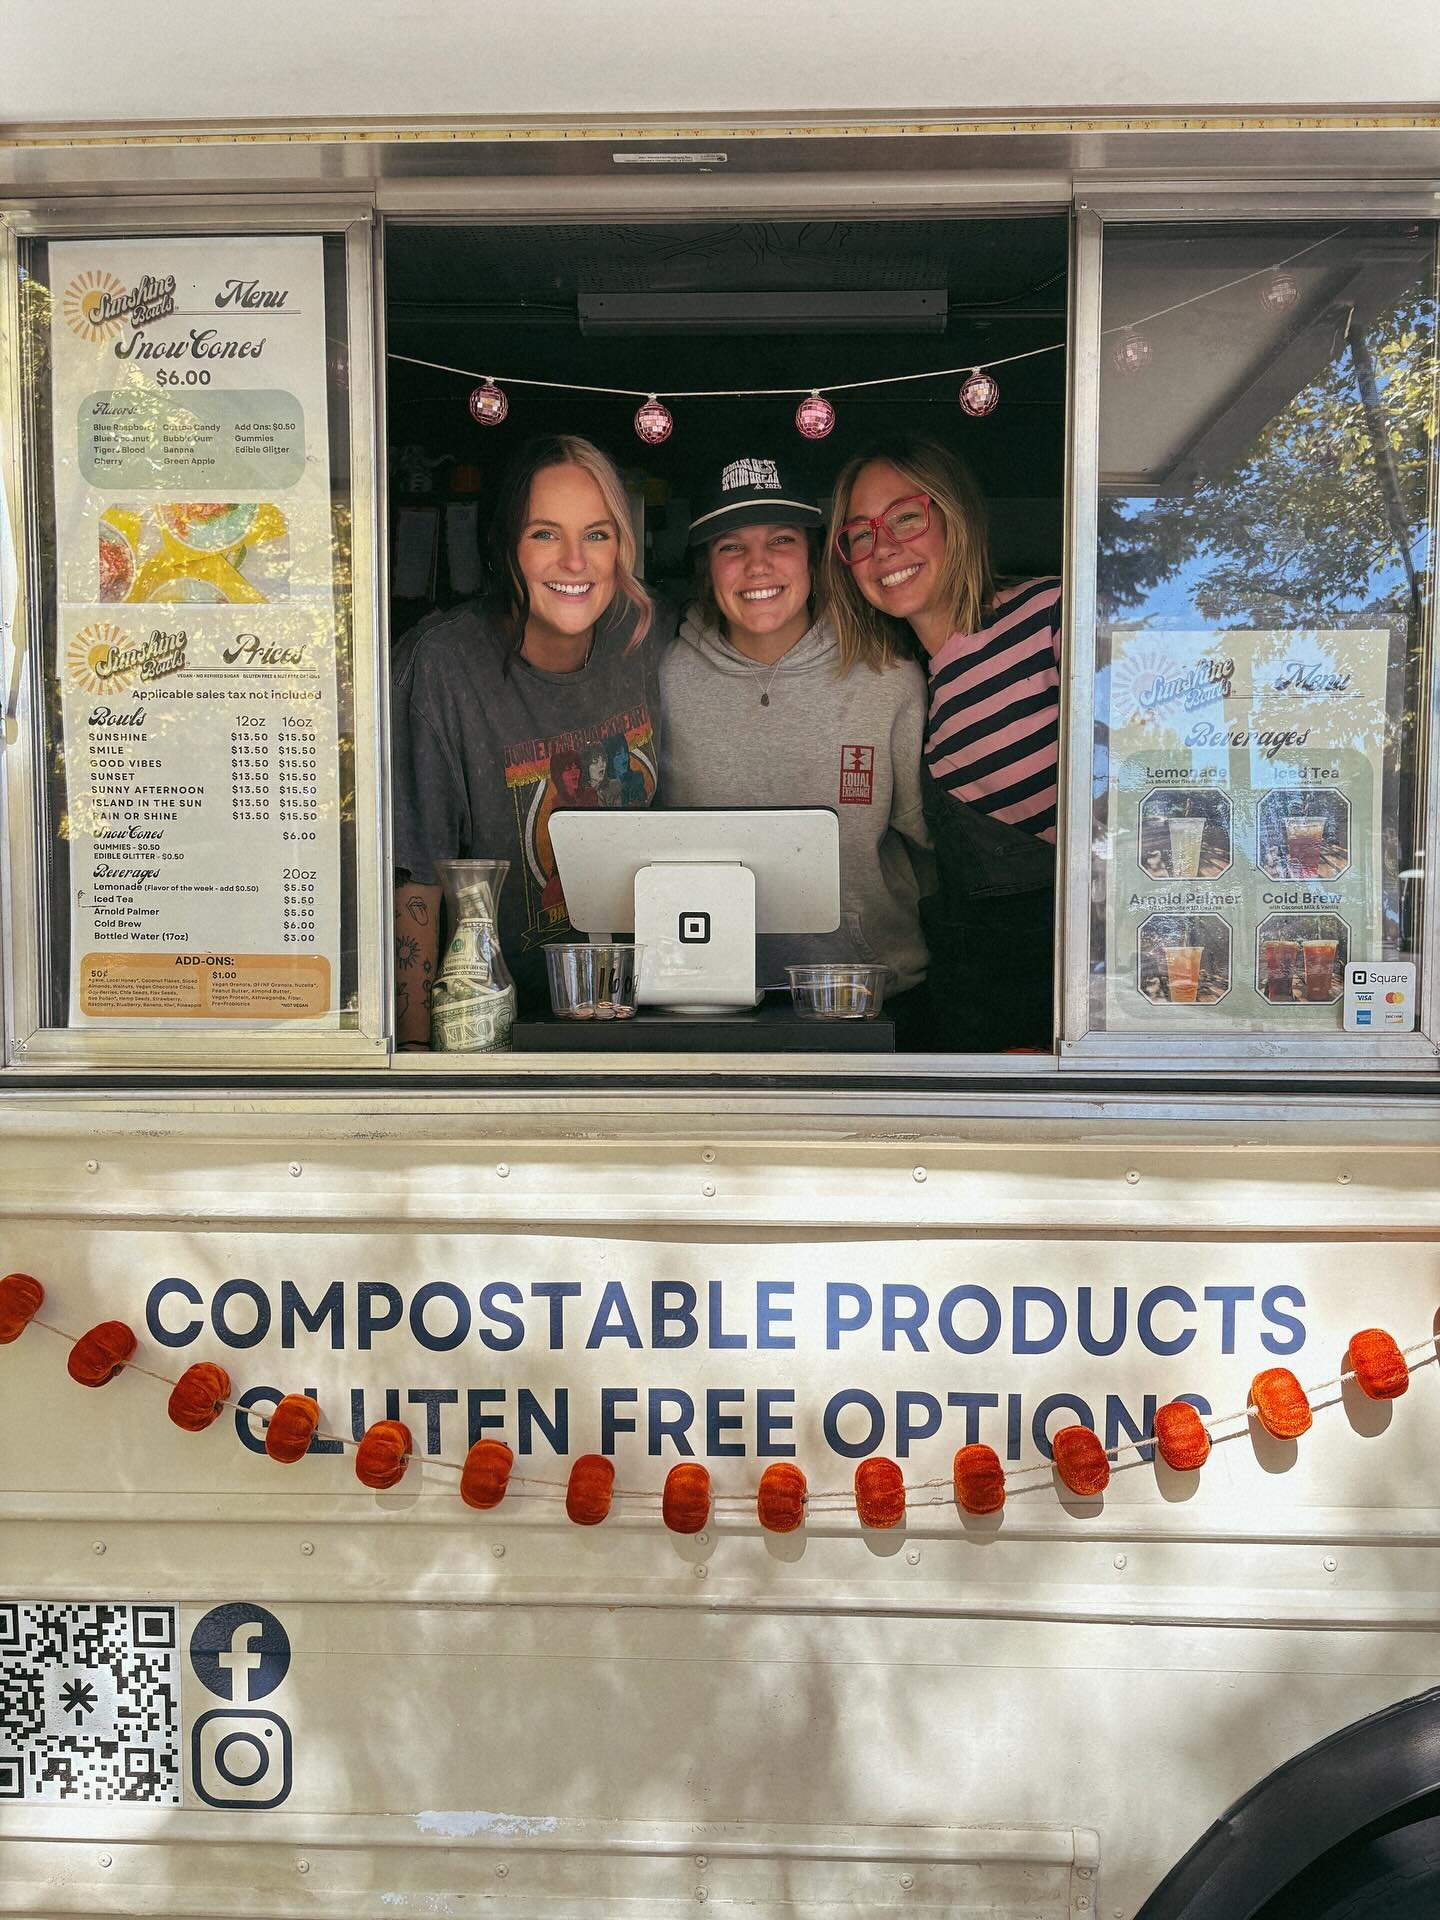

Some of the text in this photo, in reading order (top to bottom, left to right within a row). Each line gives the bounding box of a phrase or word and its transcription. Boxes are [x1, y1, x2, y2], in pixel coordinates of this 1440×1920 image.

[215, 279, 288, 308] Menu
[89, 275, 176, 326] Sunshine
[131, 298, 174, 327] Bowls
[156, 369, 211, 387] $6.00
[195, 424, 220, 432] Candy
[273, 423, 295, 431] $0.50
[235, 434, 274, 442] Gummies
[263, 446, 289, 454] Glitter
[192, 458, 215, 466] Apple
[223, 633, 306, 665] Prices
[95, 630, 188, 679] Sunshine
[140, 651, 185, 681] Bowls
[1274, 662, 1351, 691] Menu
[132, 689, 322, 701] Applicable sales tax not included
[88, 707, 313, 728] Bowls 12oz 16oz
[89, 733, 316, 742] SUNSHINE $13.50 $15.50
[1184, 721, 1312, 759] Beverages
[90, 746, 316, 755] SMILE $13.50 $15.50
[90, 759, 316, 768] GOOD VIBES $13.50 $15.50
[91, 772, 317, 782] SUNSET $13.50 $15.50
[1147, 767, 1227, 778] Lemonade
[1274, 767, 1339, 778] Iced Tea
[843, 773, 870, 787] EQUAL
[91, 785, 317, 795] SUNNY AFTERNOON $13.50 $15.50
[93, 799, 317, 808] ISLAND IN THE SUN $13.50 $15.50
[93, 812, 317, 821] RAIN OR SHINE $13.50 $15.50
[283, 832, 316, 841] $6.00
[138, 843, 160, 851] $0.50
[162, 852, 184, 860] $0.50
[93, 863, 317, 884] Beverages 20oz
[94, 883, 142, 891] Lemonade
[144, 884, 169, 892] (Flavor
[171, 884, 179, 892] of
[179, 884, 192, 892] the
[194, 884, 214, 892] week
[235, 884, 259, 893] $0.50)
[284, 884, 314, 892] $5.50
[94, 895, 314, 905] Iced Tea $5.50
[1130, 893, 1241, 905] Arnold Palmer
[1263, 892, 1342, 904] Cold Brew
[94, 908, 314, 917] Arnold Palmer $5.50
[94, 920, 315, 930] Cold Brew $6.00
[94, 932, 315, 942] Bottled Water (17oz) $3.00
[175, 956, 235, 966] ADD-ONS:
[212, 971, 237, 979] $1.00
[1370, 973, 1408, 984] Square
[145, 1277, 1308, 1357] COMPOSTABLE PRODUCTS
[600, 1387, 796, 1457] FREE
